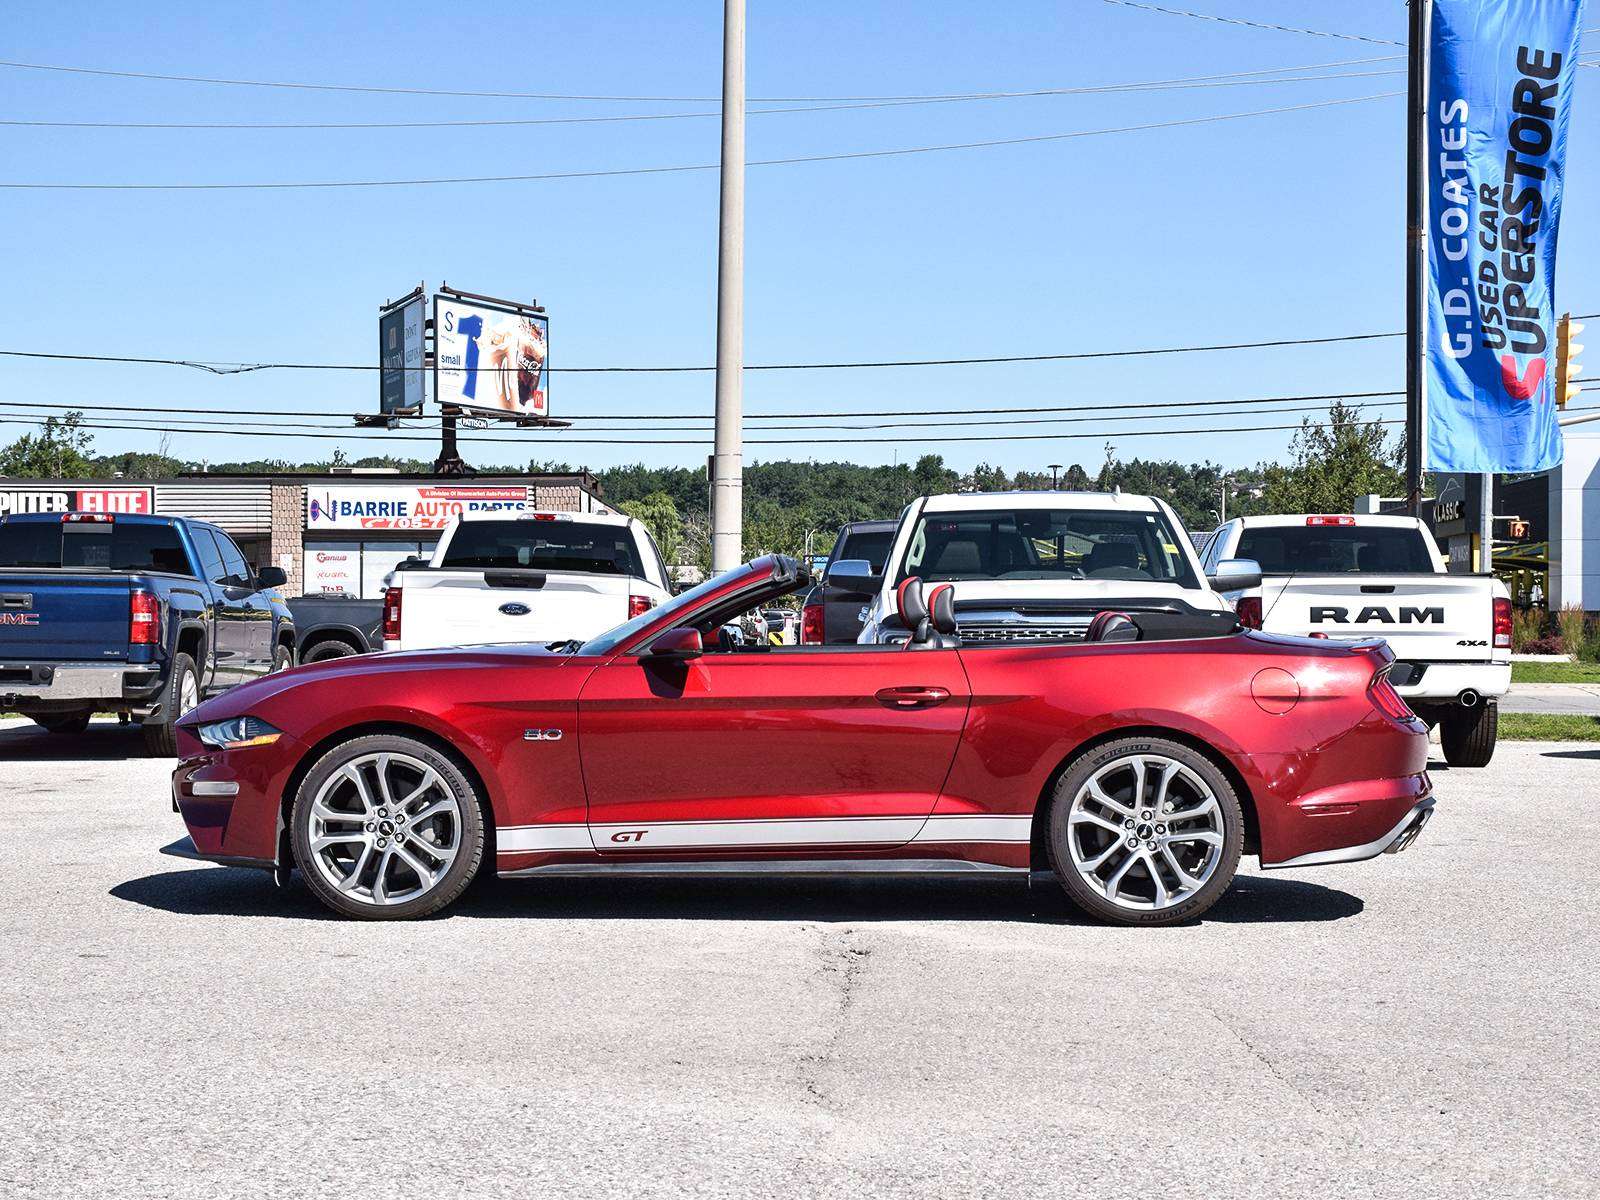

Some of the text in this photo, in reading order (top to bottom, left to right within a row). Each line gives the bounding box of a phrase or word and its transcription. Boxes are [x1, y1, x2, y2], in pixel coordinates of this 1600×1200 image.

[1440, 98, 1473, 359] G.D. COATES
[1478, 182, 1506, 350] USED CAR
[441, 354, 461, 366] small
[340, 501, 407, 517] BARRIE
[413, 502, 463, 517] AUTO
[1309, 606, 1445, 624] RAM
[523, 728, 563, 741] 5.0
[610, 830, 648, 843] GT
